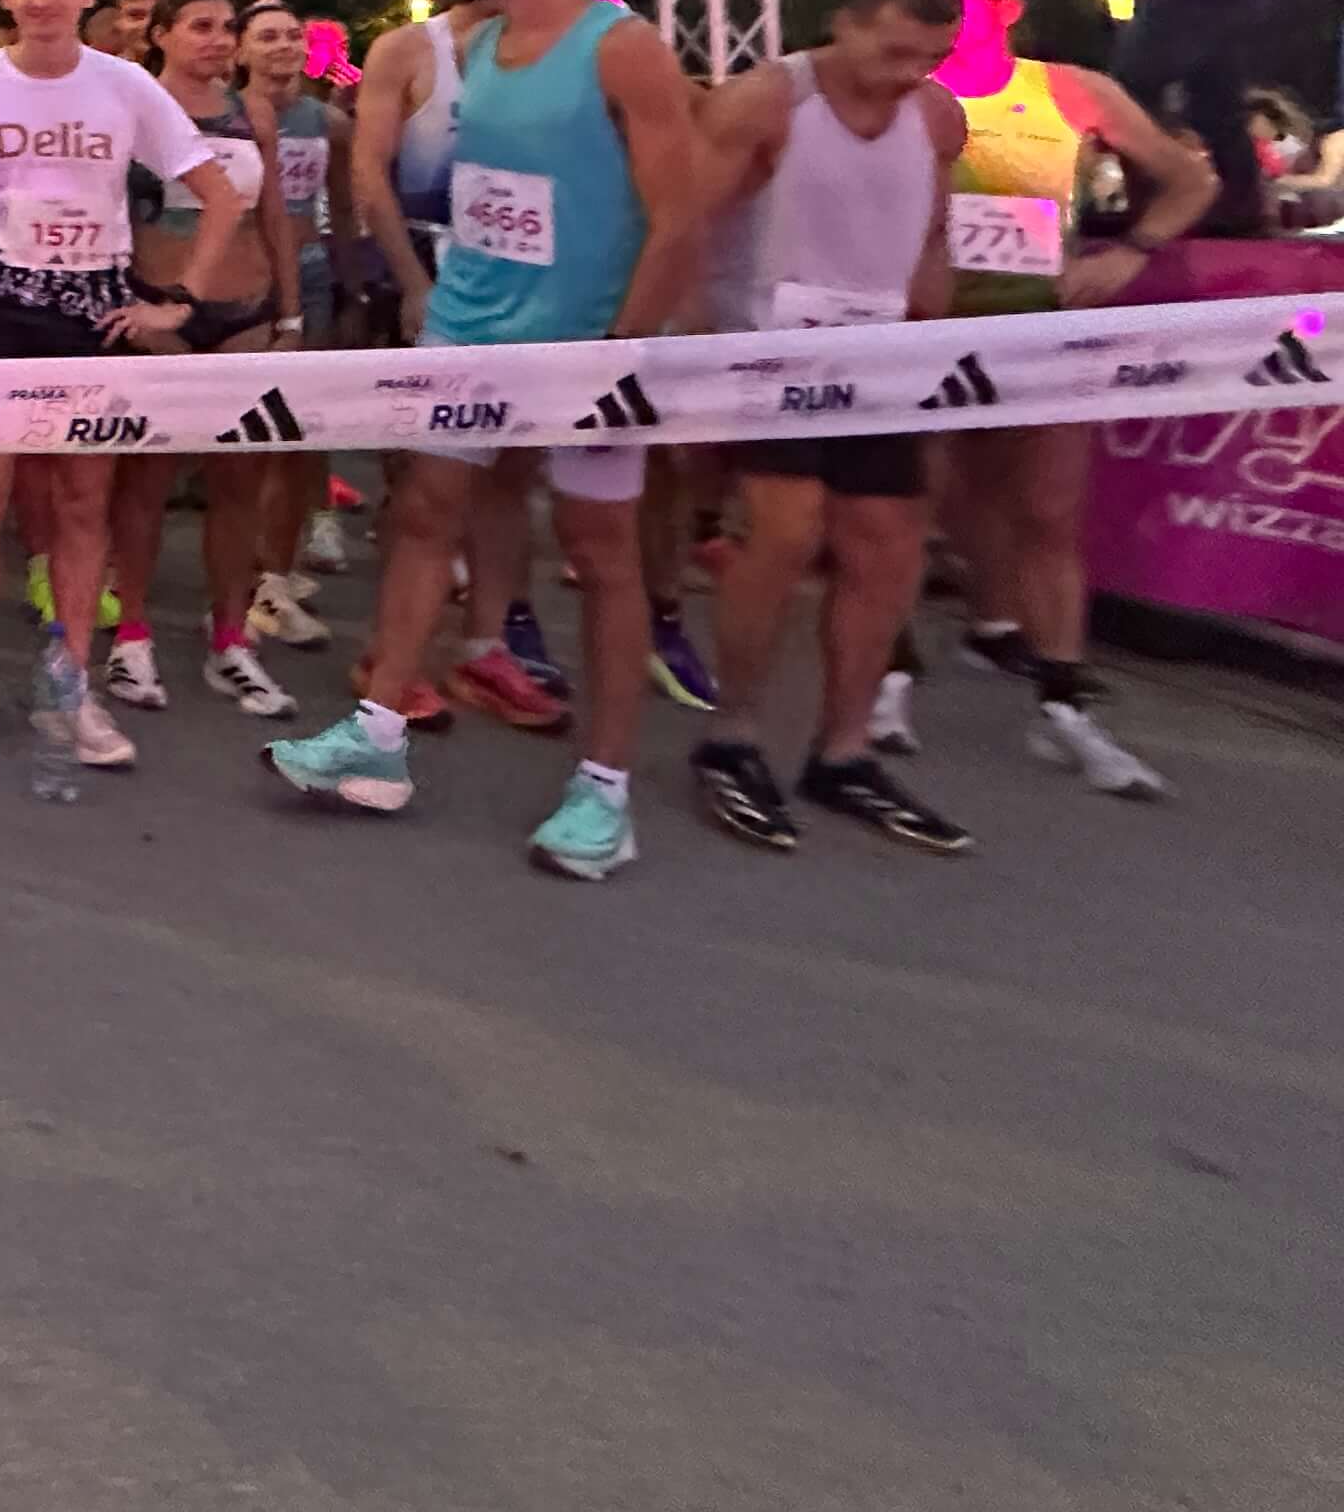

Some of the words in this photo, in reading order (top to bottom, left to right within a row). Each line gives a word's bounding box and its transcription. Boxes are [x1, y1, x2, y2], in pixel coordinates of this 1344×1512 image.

[31, 221, 104, 247] 1577
[779, 384, 855, 411] RUN
[65, 416, 148, 443] RUN
[429, 401, 510, 431] RUN
